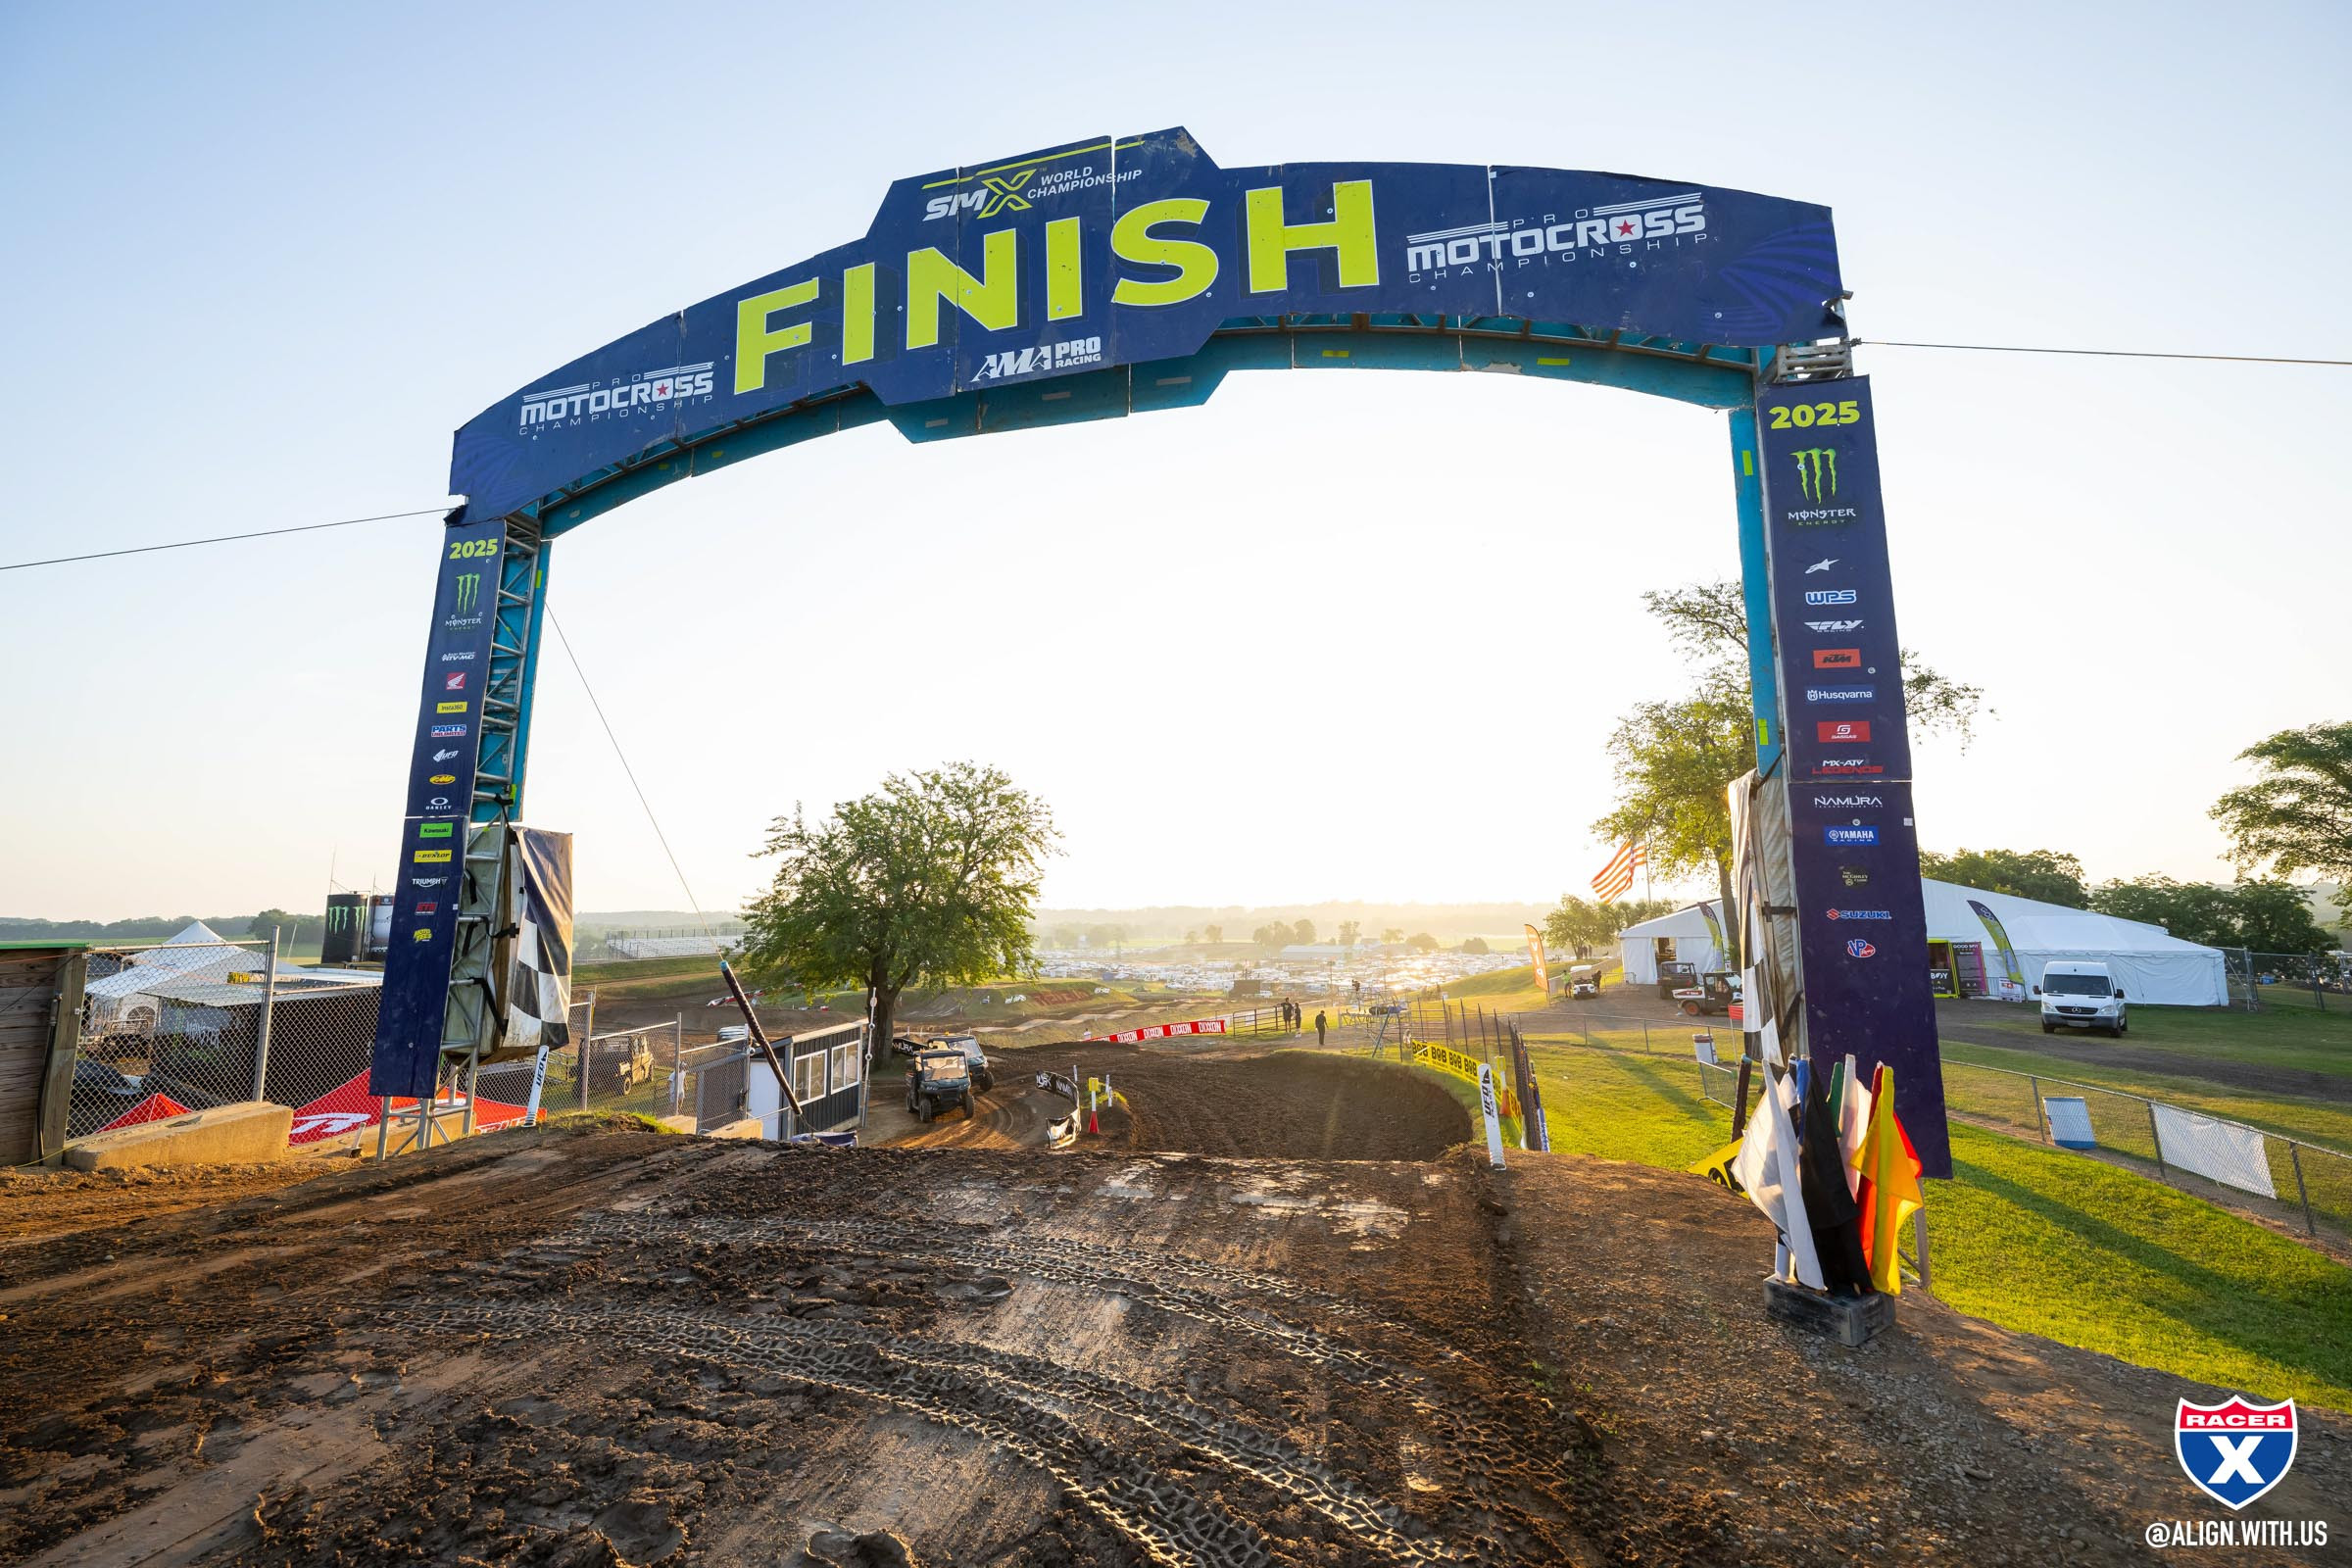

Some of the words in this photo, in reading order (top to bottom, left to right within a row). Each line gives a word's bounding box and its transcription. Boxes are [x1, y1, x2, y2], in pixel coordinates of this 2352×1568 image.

[1028, 169, 1143, 199] CHAMPIONSHIP
[1041, 166, 1093, 186] WORLD
[922, 169, 1037, 221] SMX
[1513, 209, 1589, 228] PRO
[1406, 204, 1706, 272] MOTOCROSS
[1408, 233, 1708, 284] CHAMPIONSHIP
[734, 178, 1380, 395] FINISH
[1055, 336, 1102, 359] PRO
[969, 345, 1053, 382] AMA
[1055, 353, 1102, 368] RACING
[592, 373, 641, 390] PRO
[519, 370, 714, 426] MOTOCROSS
[518, 395, 713, 436] CHAMPIONSHIP
[1769, 400, 1860, 429] 2025
[1788, 508, 1856, 520] MONSTER
[449, 539, 499, 560] 2025
[1805, 590, 1857, 605] WPS
[445, 617, 482, 627] MONSTER
[1810, 619, 1863, 630] FLY
[1823, 654, 1851, 663] KTM
[1819, 690, 1873, 701] Husqvarna
[432, 724, 466, 733] PARTS
[1814, 796, 1883, 806] NAMURA
[1838, 830, 1874, 839] YAMAHA
[412, 878, 441, 888] TRIUMPH
[1840, 910, 1890, 919] SUZUKI
[1847, 939, 1867, 957] VP
[1431, 1046, 1447, 1063] BOB
[1448, 1052, 1462, 1069] BOB
[1464, 1057, 1478, 1077] BOB
[535, 1060, 544, 1087] UFO
[1482, 1085, 1492, 1116] UFO
